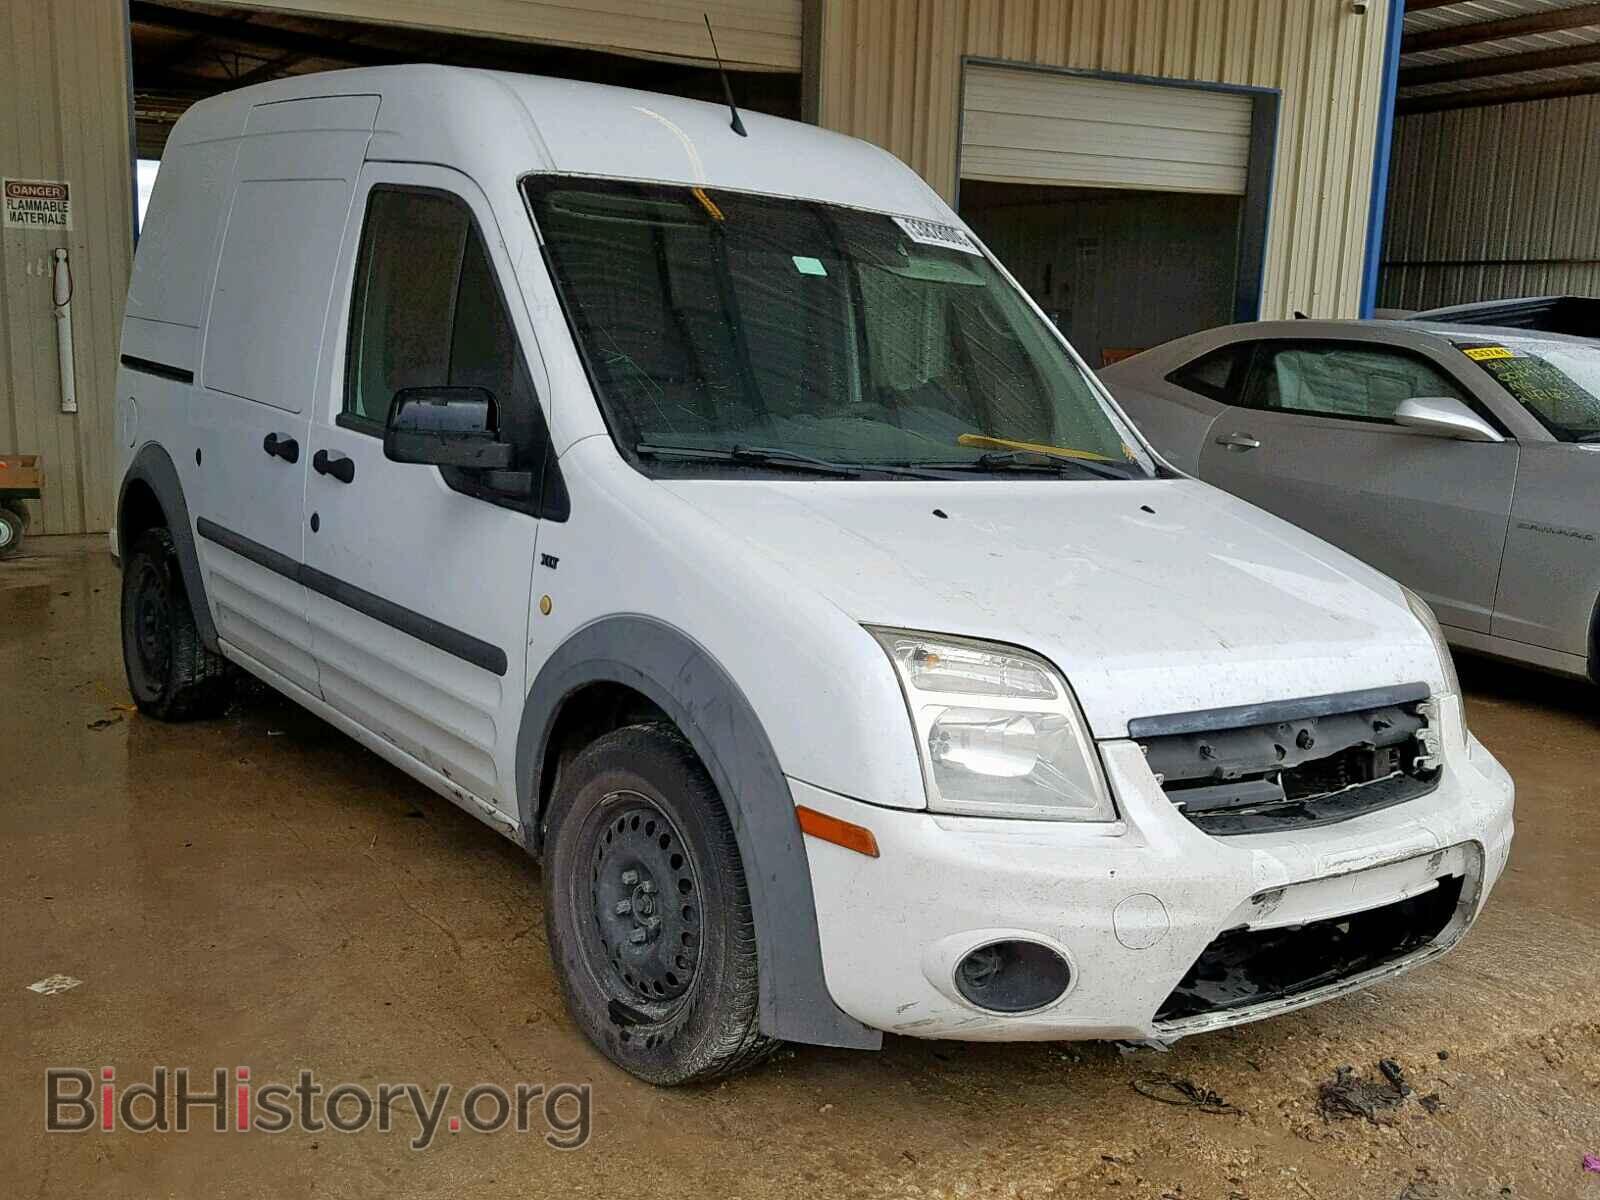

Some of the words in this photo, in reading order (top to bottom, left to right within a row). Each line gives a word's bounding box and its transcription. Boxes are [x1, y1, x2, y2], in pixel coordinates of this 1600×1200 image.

[12, 185, 61, 197] DANGER
[6, 199, 69, 213] FLAMMABLE
[9, 211, 67, 225] MATERIALS
